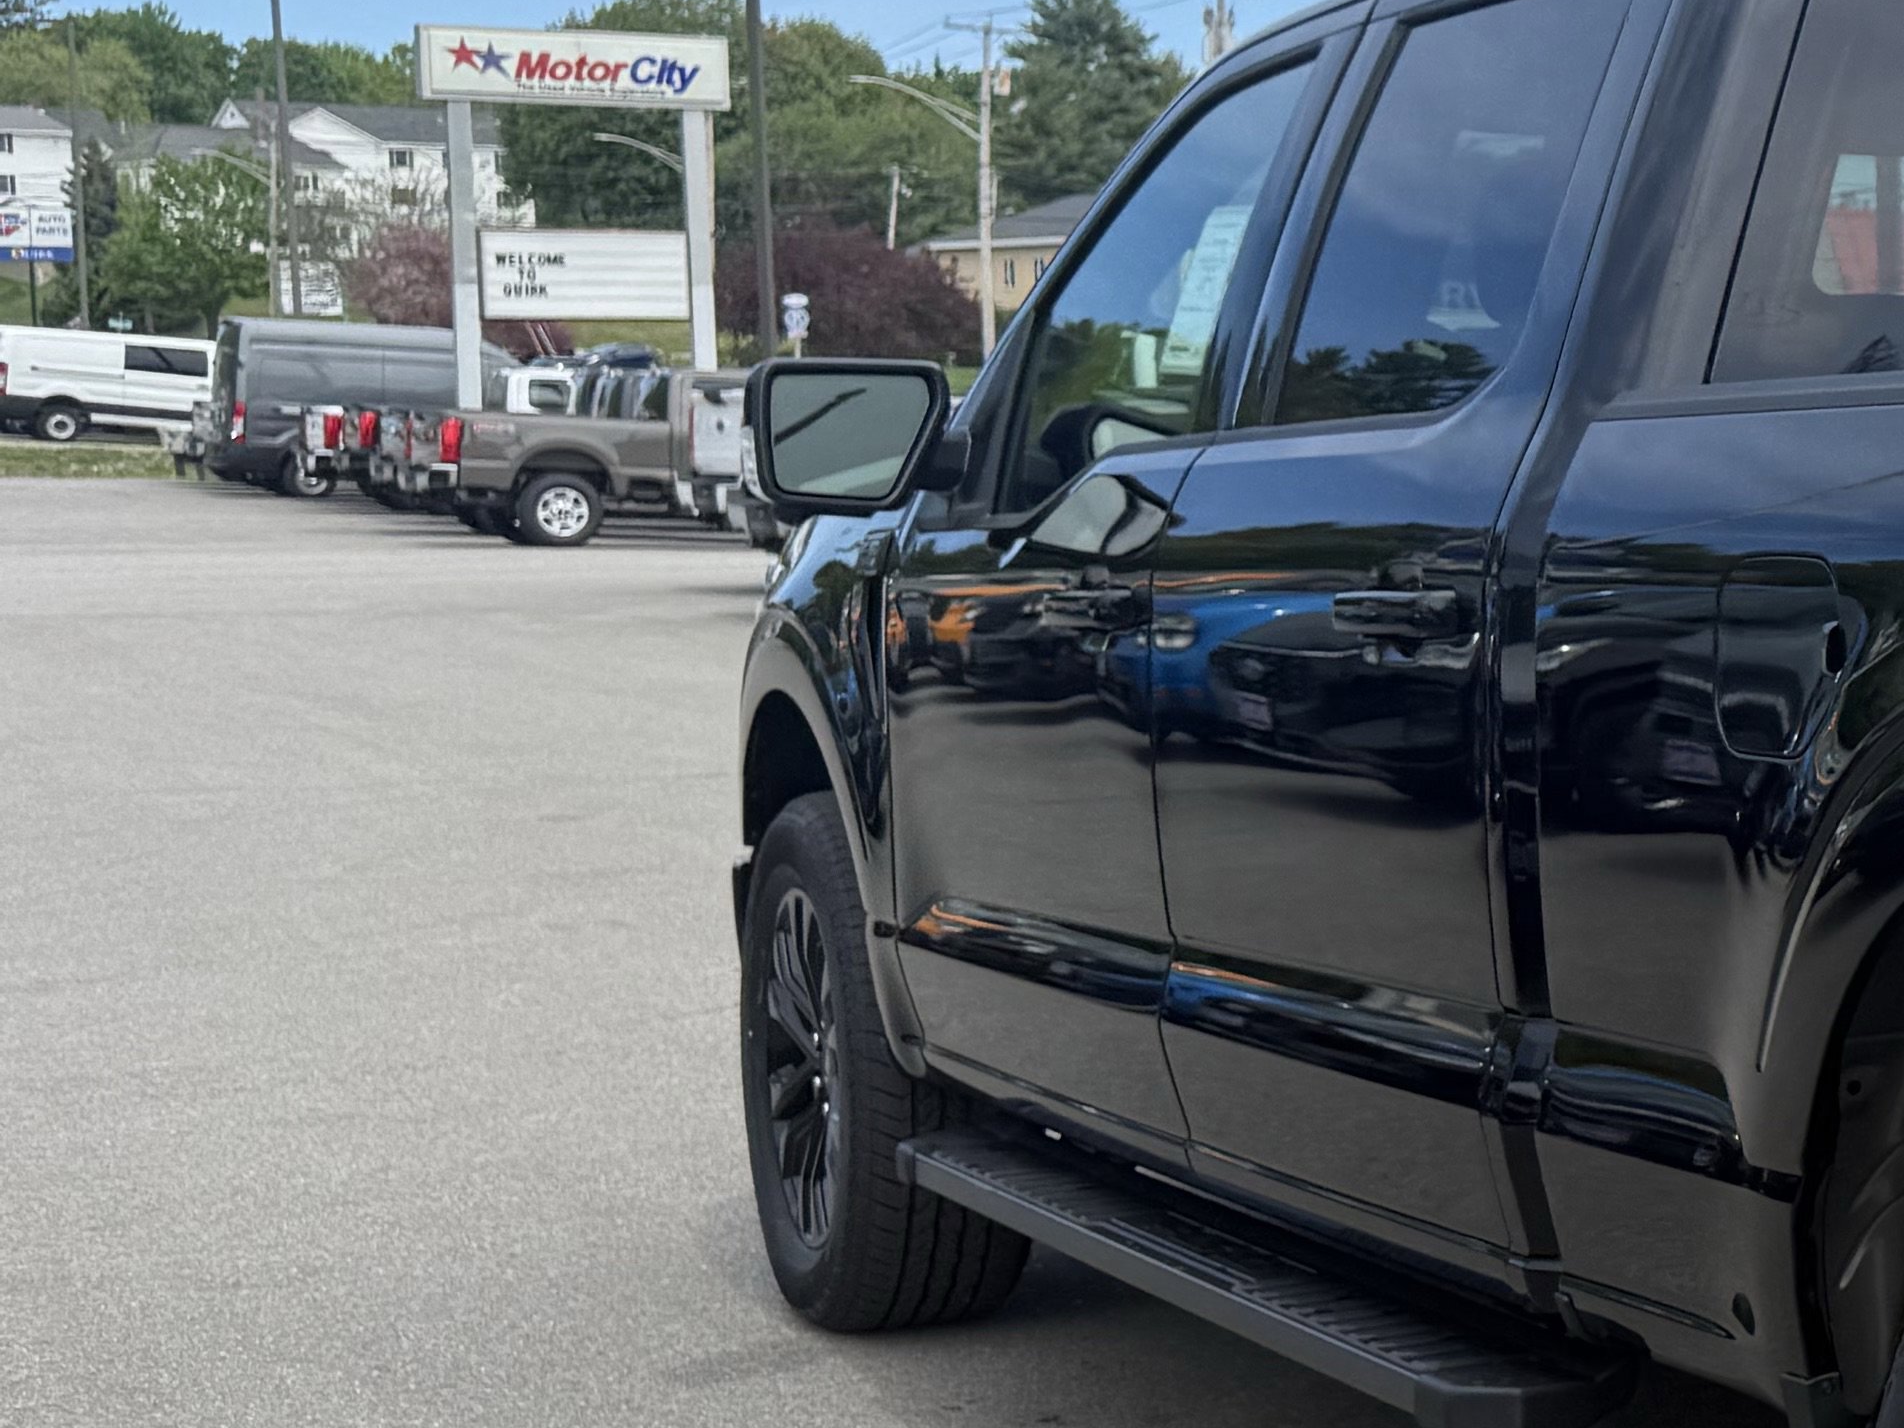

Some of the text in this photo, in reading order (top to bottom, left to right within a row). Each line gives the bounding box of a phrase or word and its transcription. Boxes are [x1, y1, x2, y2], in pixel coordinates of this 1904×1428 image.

[514, 50, 699, 94] MotorCity
[496, 252, 566, 267] WELCOME
[518, 268, 536, 282] TO
